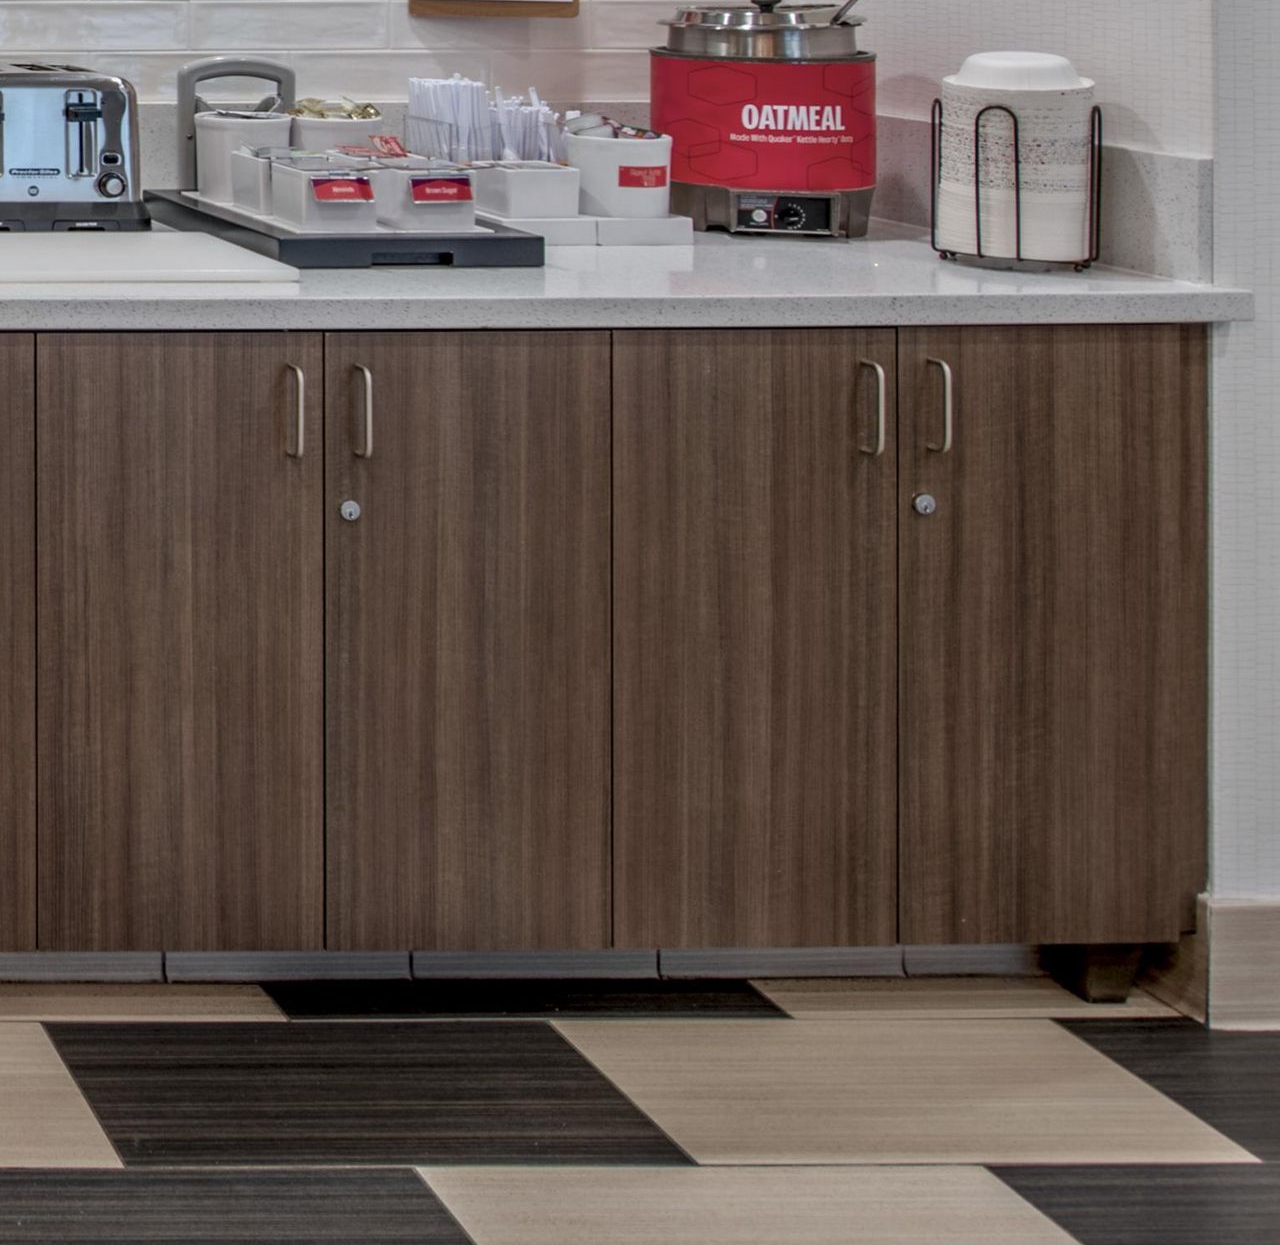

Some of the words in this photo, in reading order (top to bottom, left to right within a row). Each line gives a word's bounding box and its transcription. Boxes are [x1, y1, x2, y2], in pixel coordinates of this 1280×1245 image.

[741, 104, 846, 130] OATMEAL
[730, 133, 750, 142] Made
[797, 135, 817, 143] Kettle
